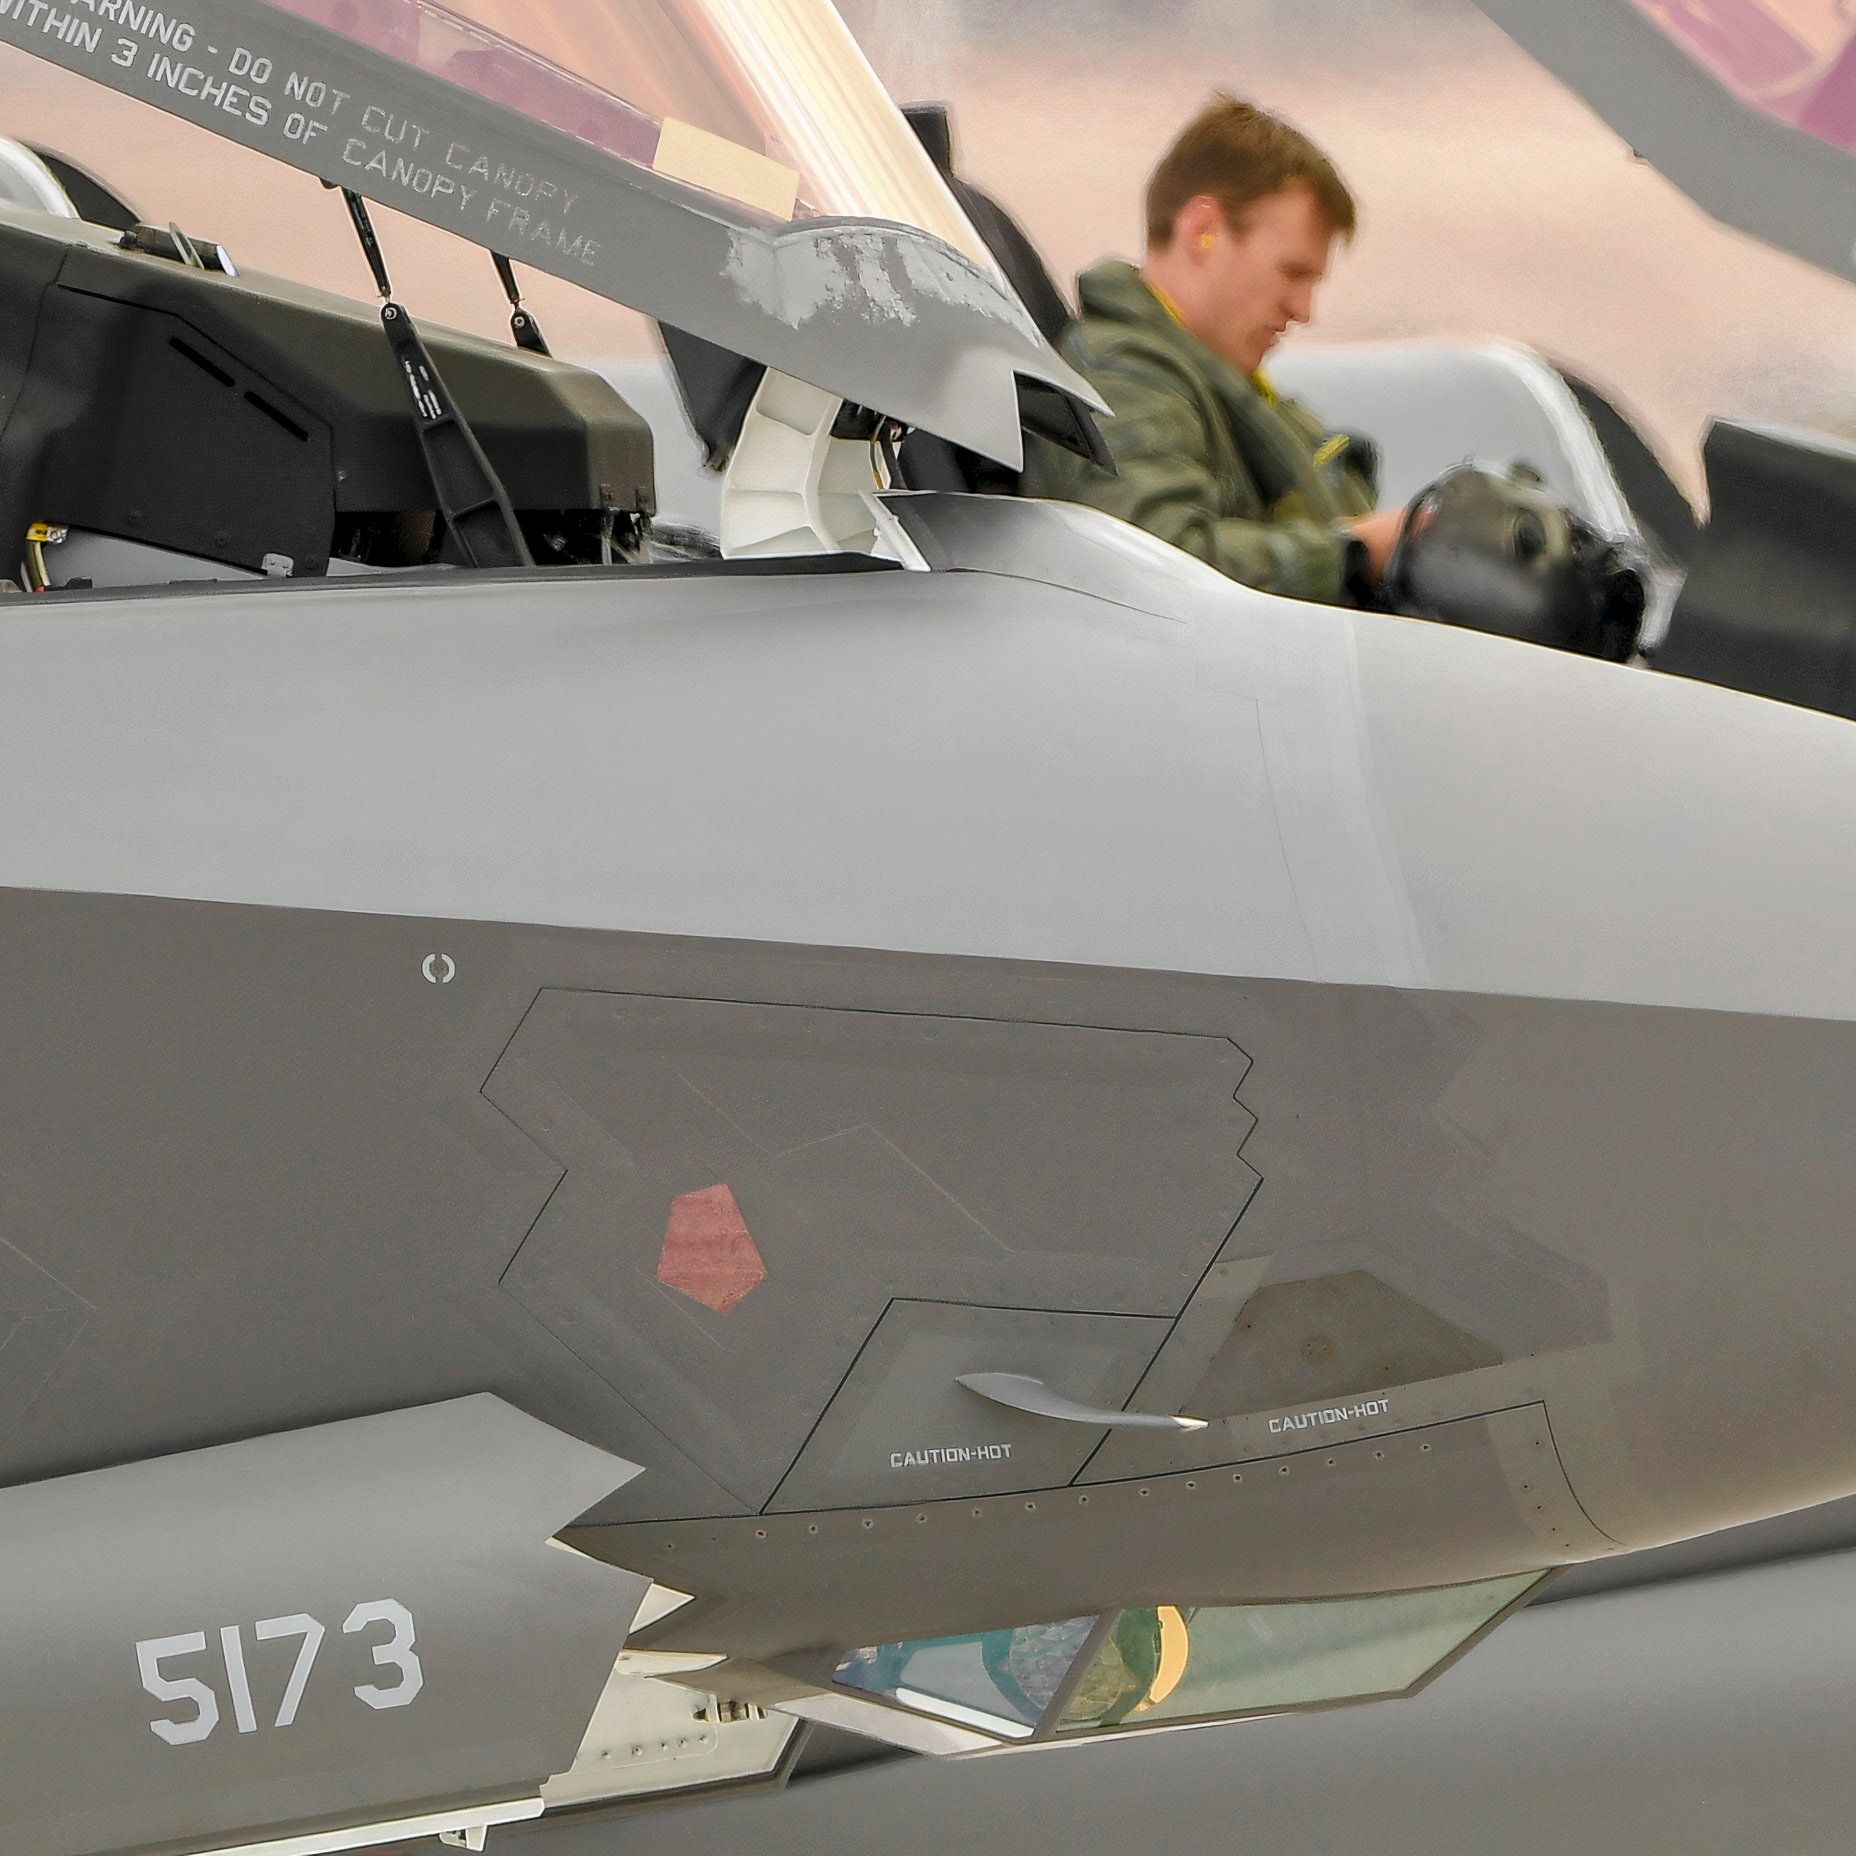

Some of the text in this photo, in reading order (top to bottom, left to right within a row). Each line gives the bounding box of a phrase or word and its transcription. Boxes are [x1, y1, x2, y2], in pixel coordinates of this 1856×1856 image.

[110, 39, 137, 68] 3
[147, 55, 273, 126] INCHES
[282, 111, 329, 146] OF
[341, 139, 479, 213] CANOPY
[485, 199, 602, 267] FRAME
[227, 47, 273, 85] DO
[285, 73, 349, 117] NOT
[362, 105, 430, 149] CUT
[446, 143, 580, 214] CANOPY
[889, 1442, 1013, 1469] CAUTION-HOT
[1268, 1398, 1390, 1435] CAUTION-HOT
[136, 1597, 424, 1746] 5173
